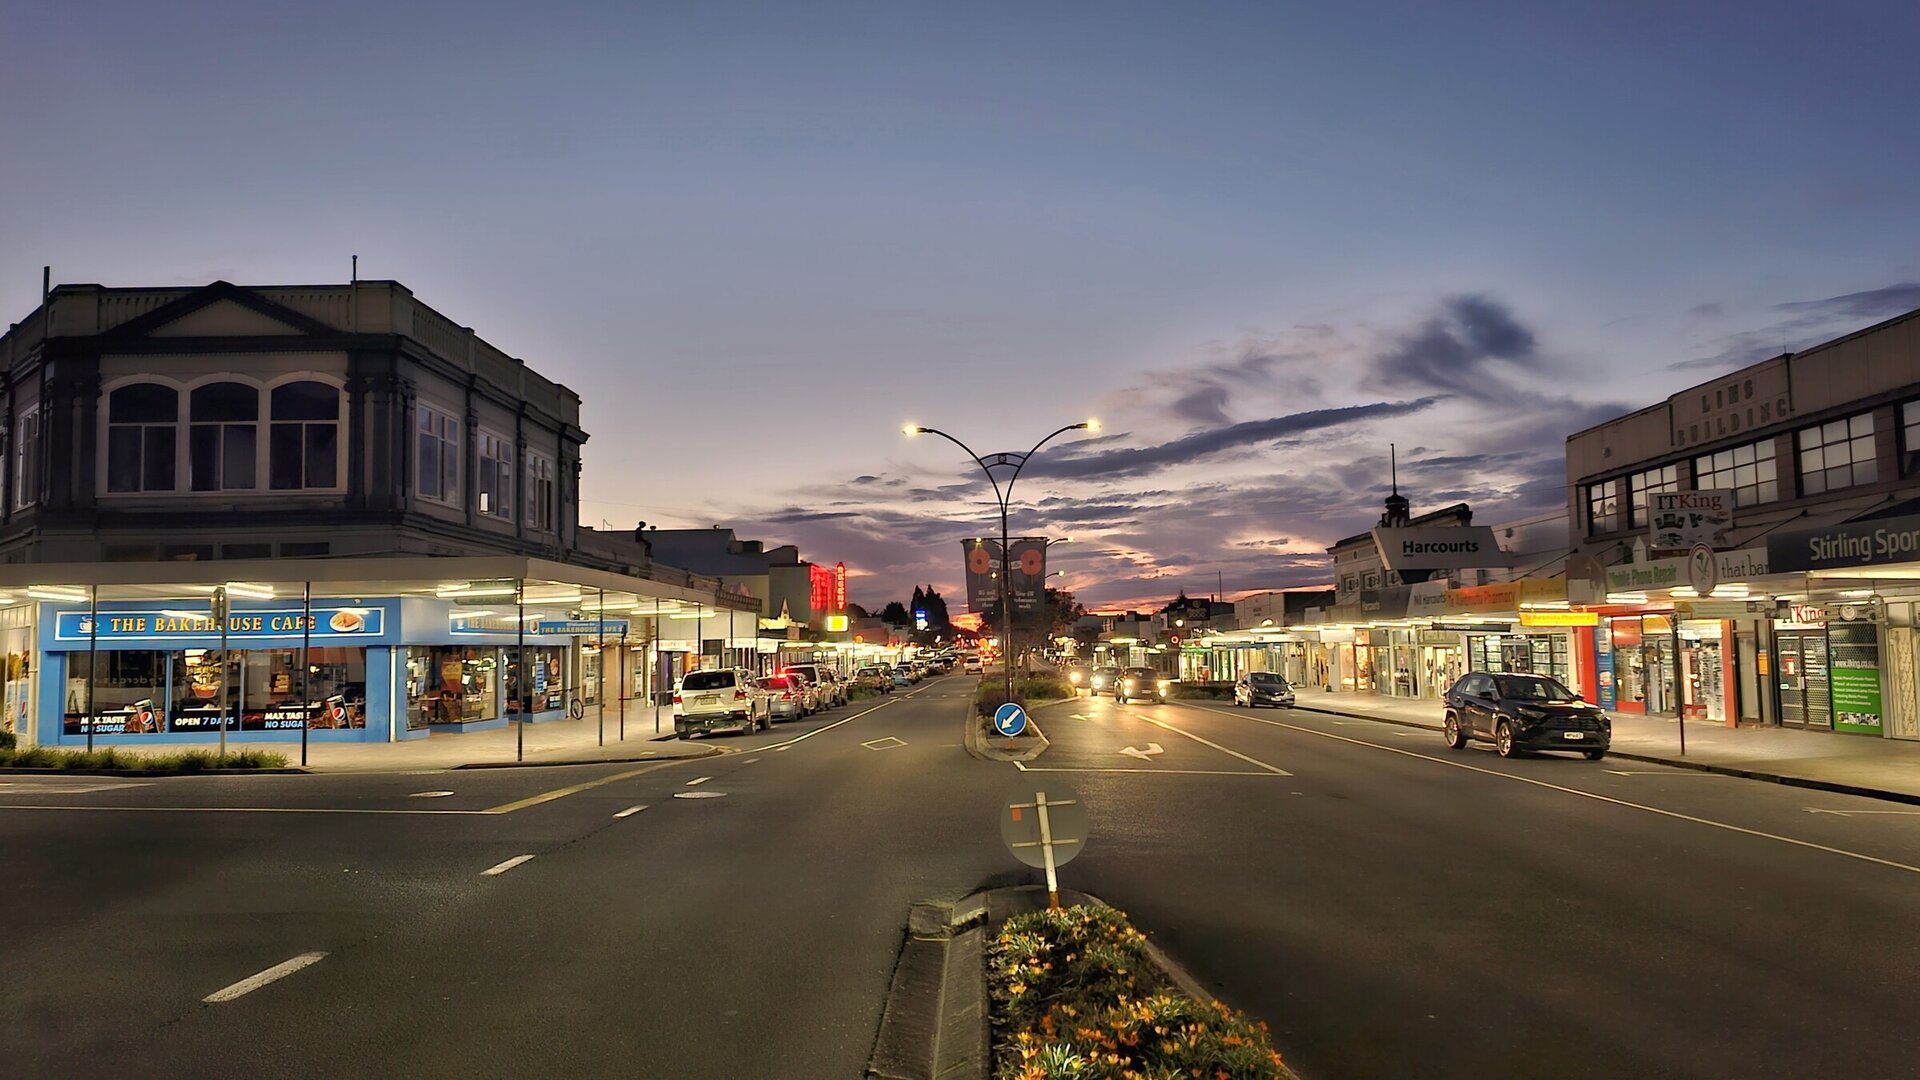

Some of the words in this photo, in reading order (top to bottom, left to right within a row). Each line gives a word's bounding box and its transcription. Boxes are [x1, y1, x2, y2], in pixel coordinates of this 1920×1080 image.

[1677, 398, 1787, 448] BUILDING
[1657, 493, 1722, 511] ITKing
[1402, 540, 1479, 554] Harcourts
[1809, 532, 1872, 562] Stirling
[1875, 528, 1920, 559] Spor
[1721, 556, 1746, 579] that
[111, 617, 146, 633] THE
[154, 616, 262, 633] BAKEHUSE
[80, 716, 101, 724] MX
[102, 715, 126, 724] TASTE
[175, 717, 201, 726] OPEN
[202, 716, 209, 725] 7
[264, 712, 285, 720] MAX
[96, 724, 126, 733] SUGAR
[265, 720, 279, 729] NO
